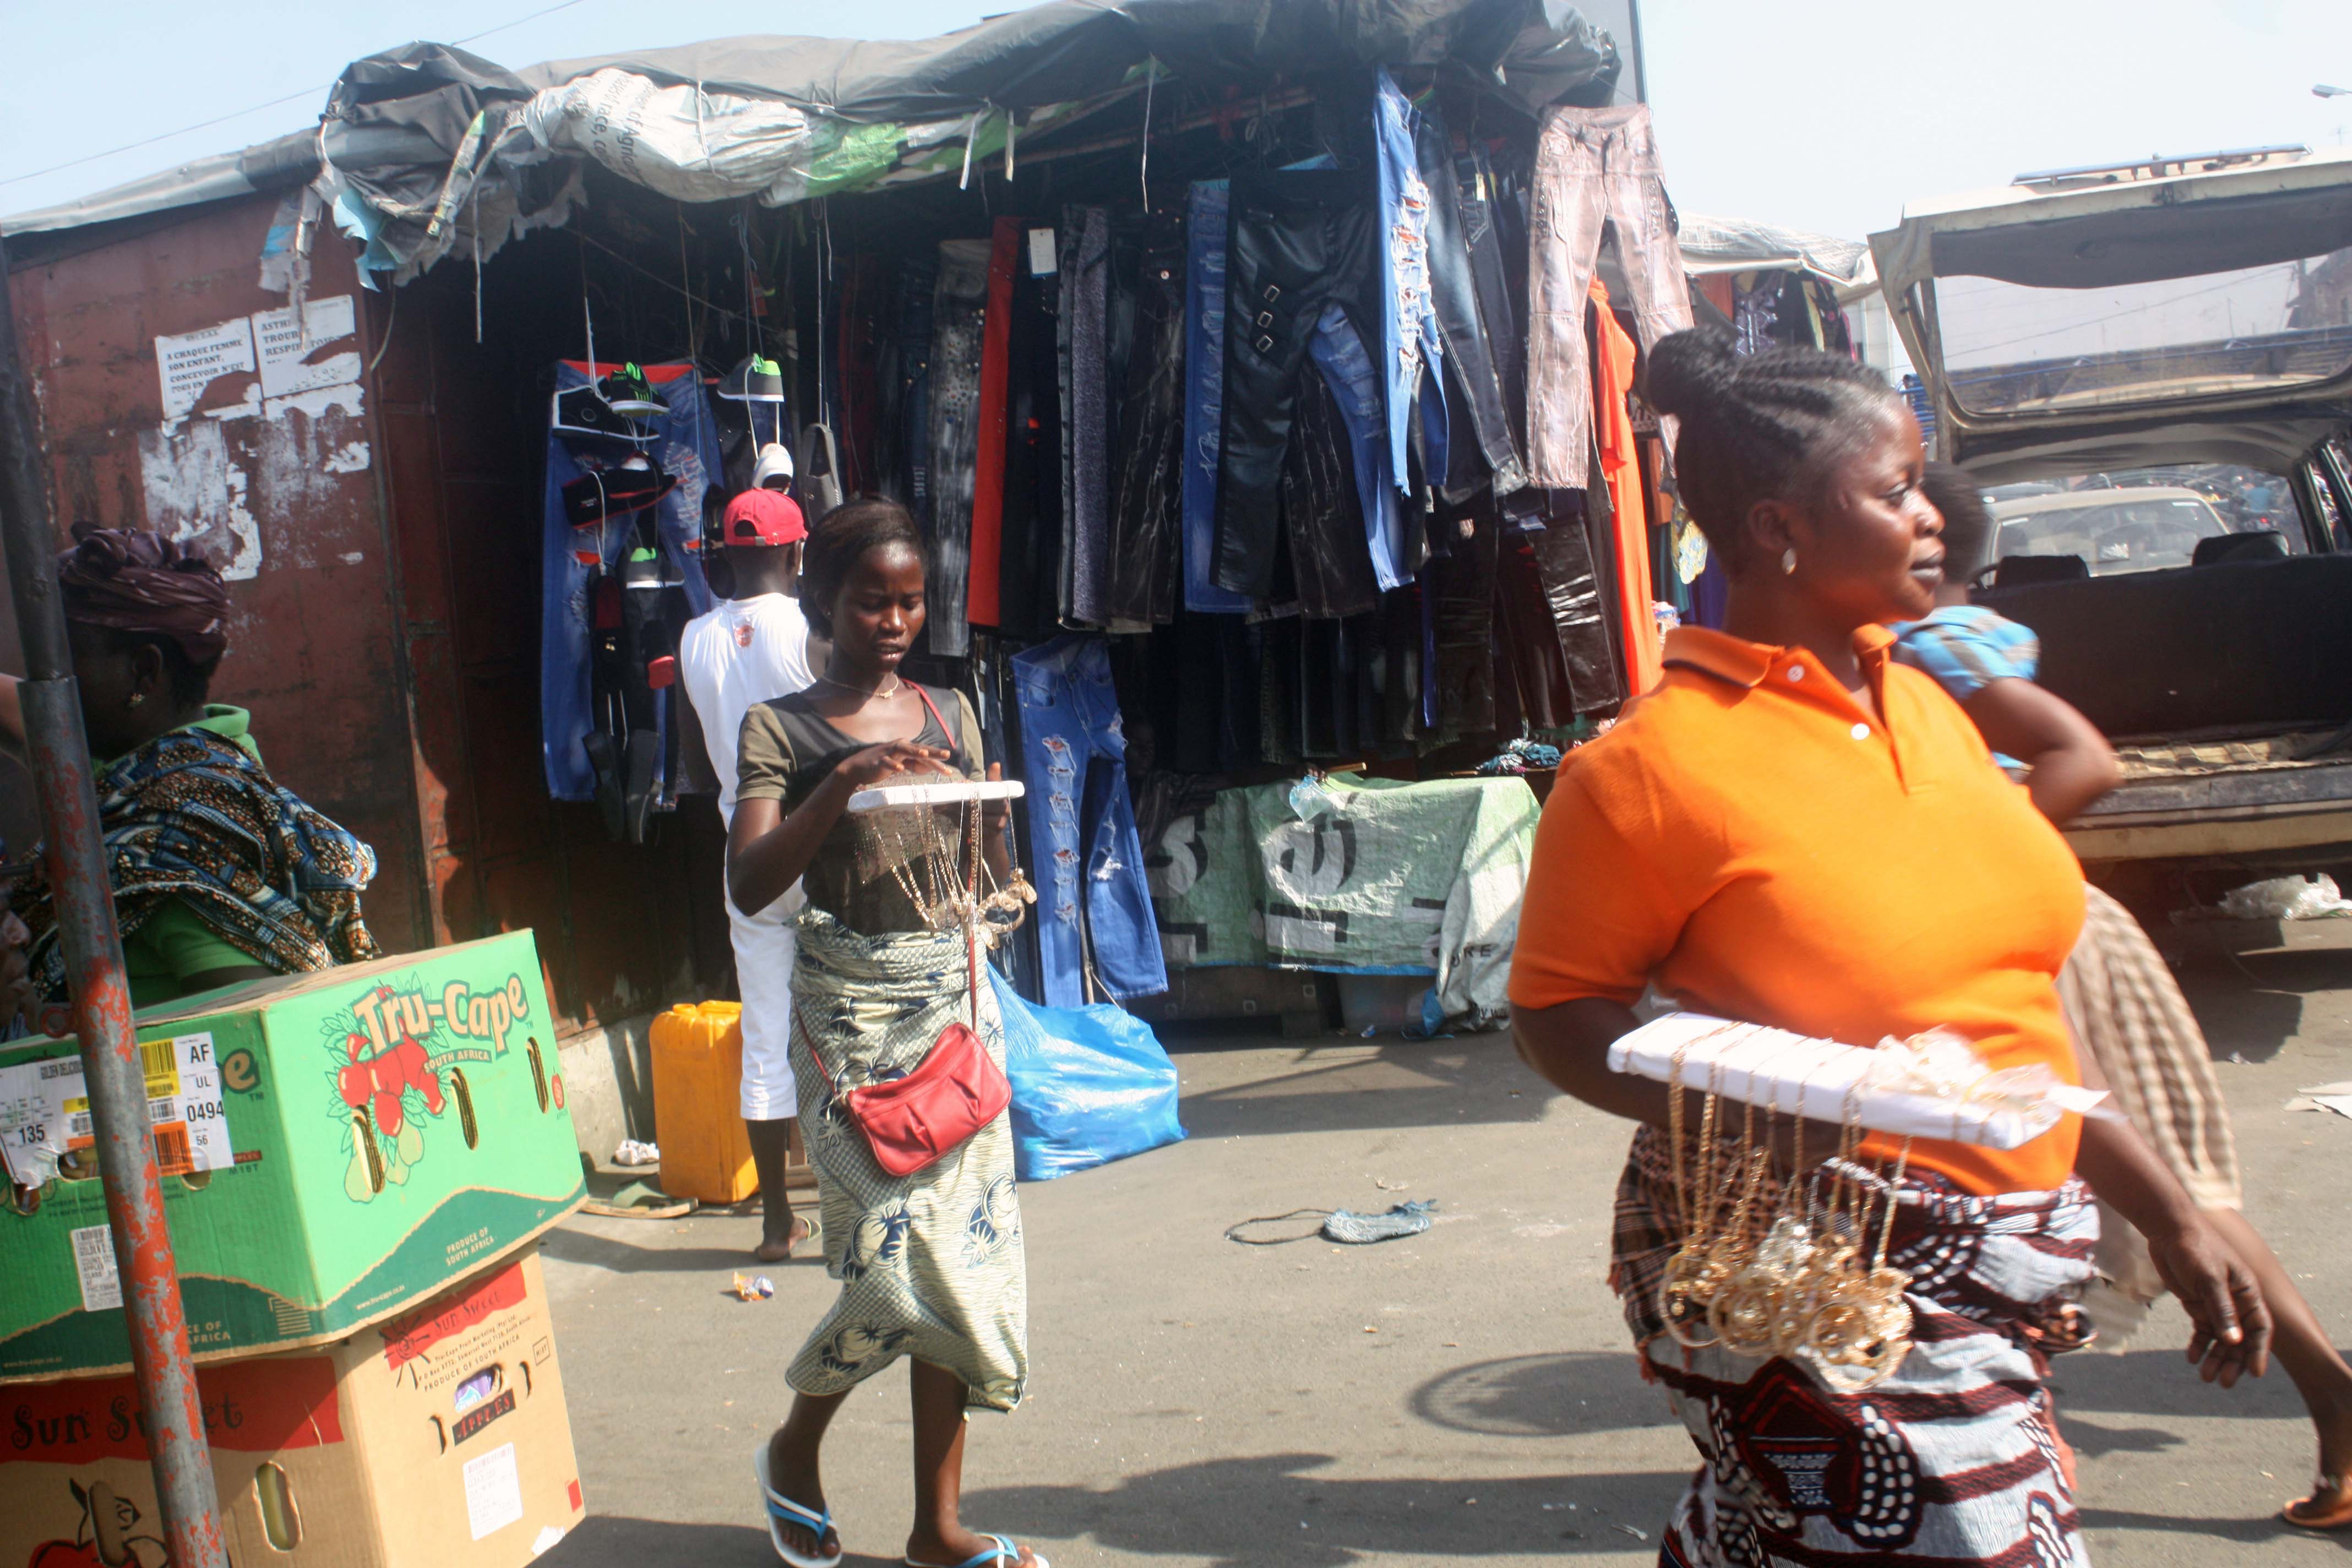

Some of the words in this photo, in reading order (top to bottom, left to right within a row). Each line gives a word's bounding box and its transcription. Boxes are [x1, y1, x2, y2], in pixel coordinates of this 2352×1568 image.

[210, 339, 243, 352] FEMME
[168, 361, 186, 372] SON
[351, 974, 529, 1058] Tru-Cape
[190, 1043, 209, 1064] AF
[423, 1053, 454, 1072] SOUTH
[456, 1049, 490, 1062] AFRICA
[196, 1075, 211, 1088] UL
[187, 1100, 225, 1123] 0494
[19, 1124, 45, 1145] 135
[196, 1134, 209, 1146] 56
[445, 1249, 469, 1266] SOUTH
[471, 1235, 494, 1255] AFRICA
[447, 1232, 478, 1255] PRODUCE
[479, 1226, 488, 1238] OF
[205, 1321, 221, 1331] OF
[434, 1313, 457, 1337] Sun
[424, 1368, 459, 1392] PRODUCE
[463, 1362, 472, 1371] OF
[475, 1348, 496, 1365] SOUTH
[498, 1334, 520, 1355] AFRICA
[10, 1404, 91, 1450] Sun
[107, 1392, 243, 1442] Set
